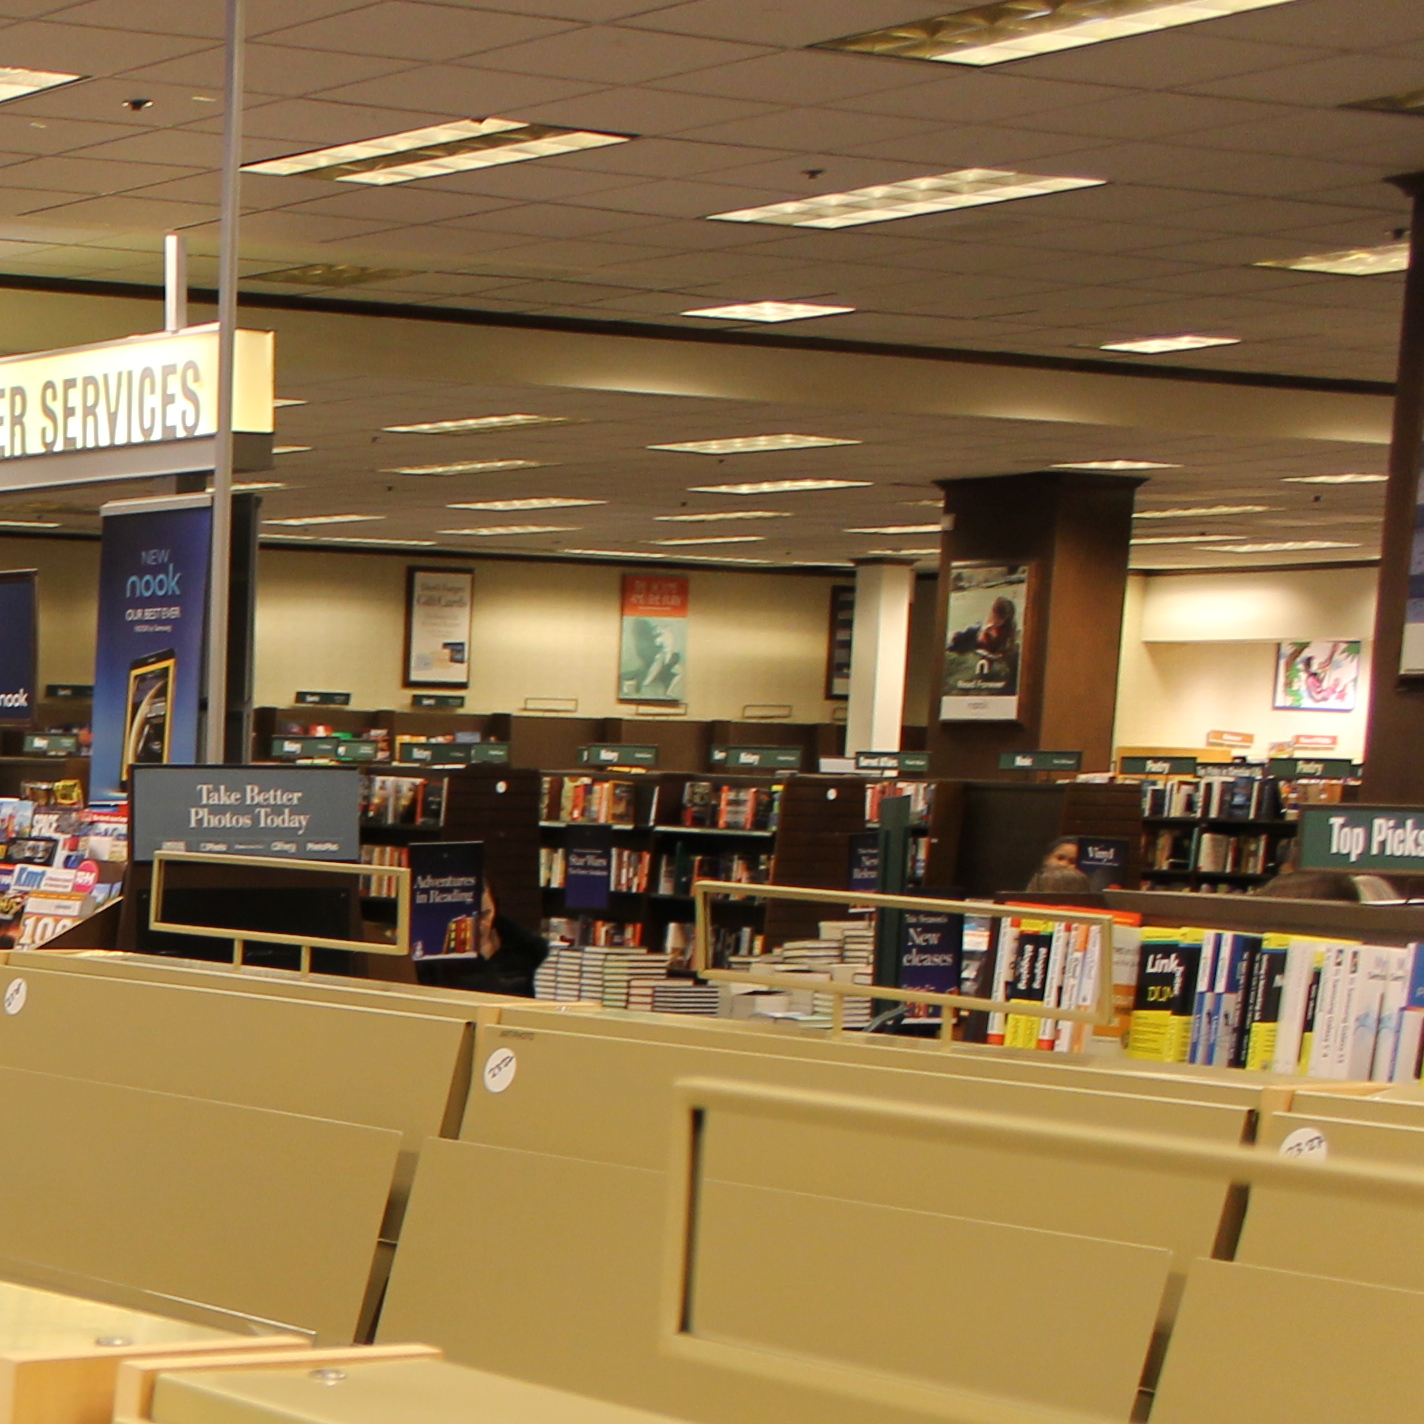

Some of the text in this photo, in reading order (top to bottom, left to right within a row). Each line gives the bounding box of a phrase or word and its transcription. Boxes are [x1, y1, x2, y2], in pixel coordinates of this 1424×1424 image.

[41, 359, 202, 451] SERVICES
[141, 549, 170, 566] NEW
[125, 563, 182, 598] nook
[1145, 759, 1170, 775] Poetry
[1297, 761, 1324, 776] Poetry
[197, 784, 302, 805] Take Better
[189, 807, 310, 835] Photos Today
[1328, 816, 1424, 862] Top Picks
[1087, 845, 1115, 862] Vinyl
[414, 875, 476, 888] Adventures
[416, 890, 474, 904] in Reading
[907, 927, 942, 946] New
[903, 948, 953, 966] eleases
[1146, 952, 1179, 973] Link
